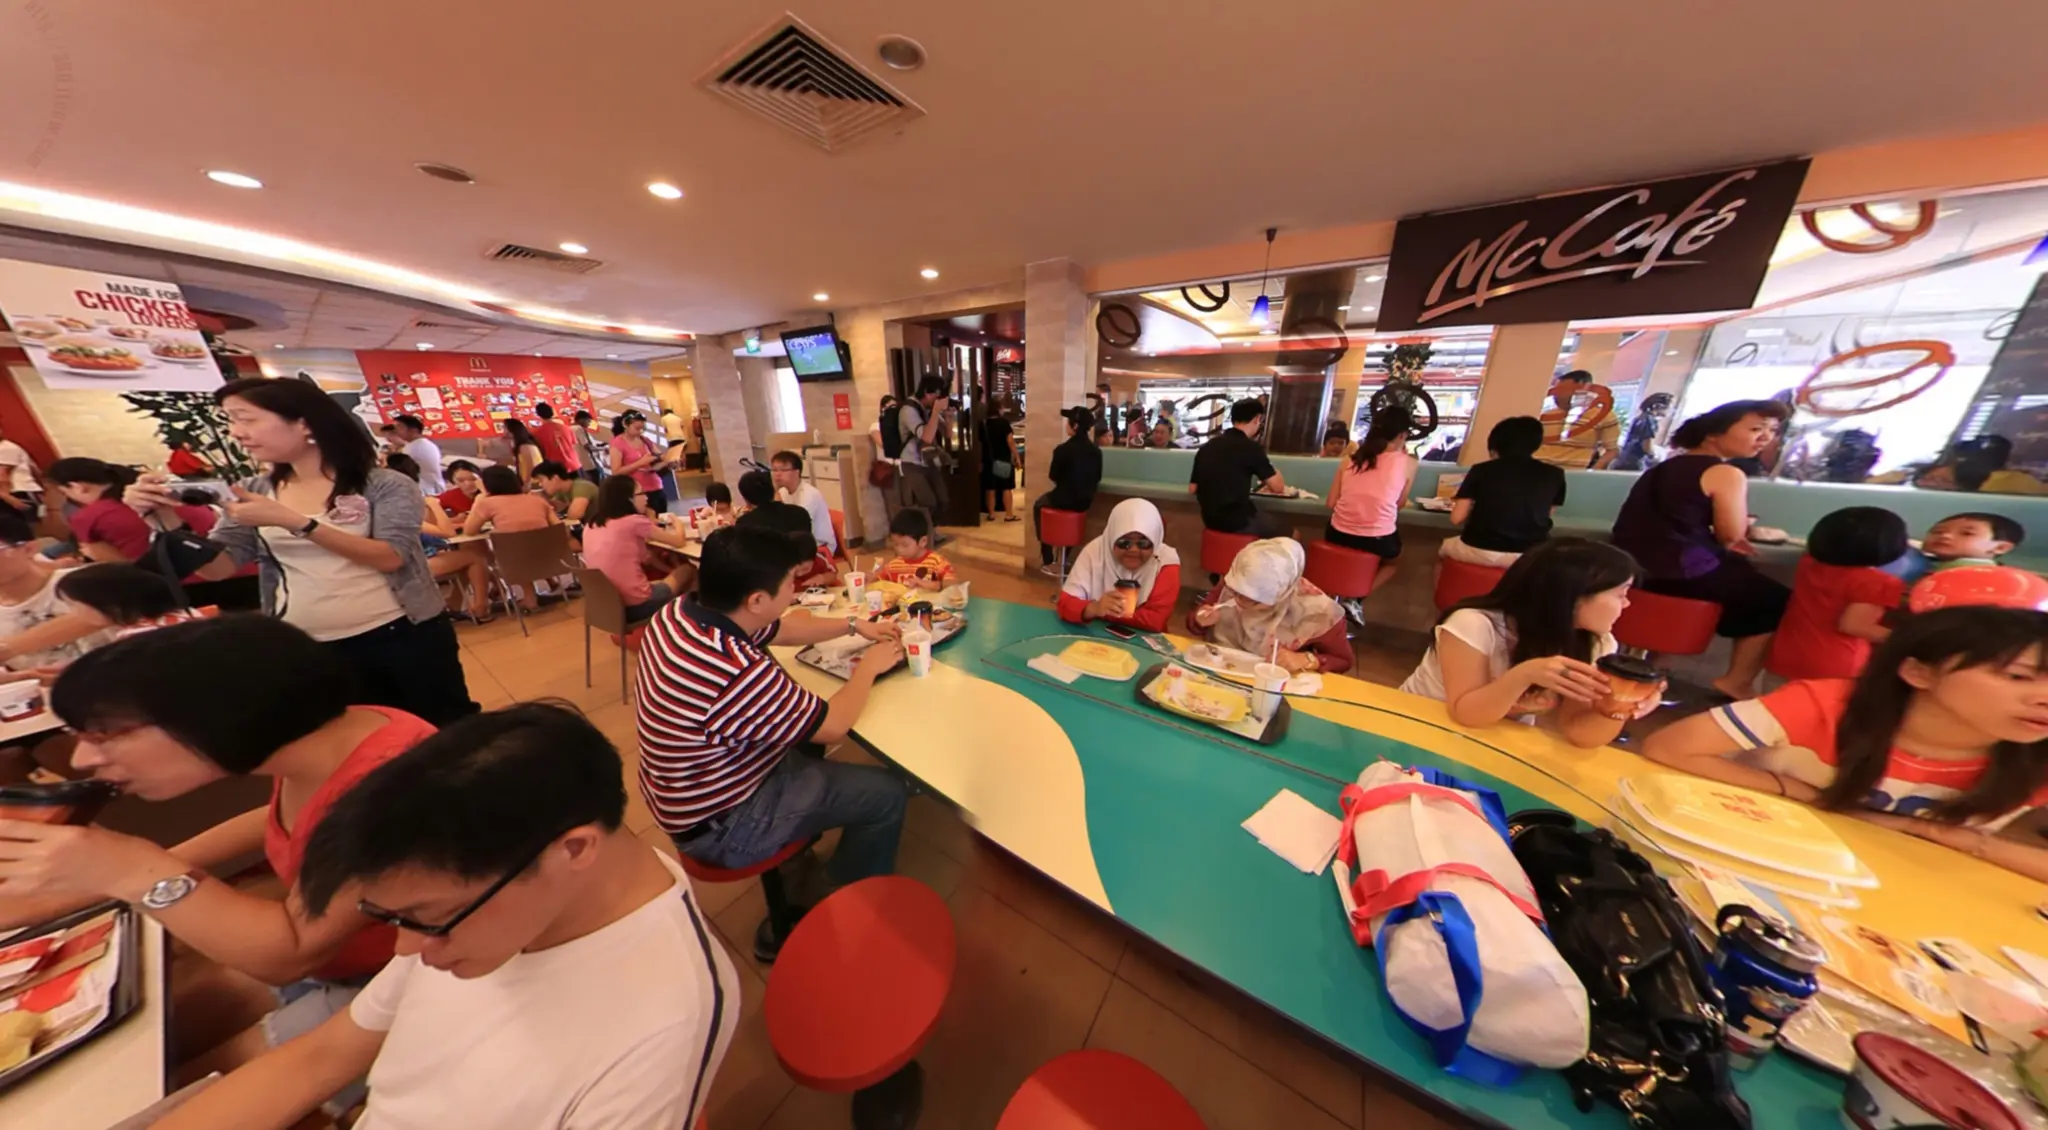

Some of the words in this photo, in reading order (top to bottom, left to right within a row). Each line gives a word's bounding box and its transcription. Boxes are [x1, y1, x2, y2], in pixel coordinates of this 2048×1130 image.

[1423, 169, 1758, 308] McCafé
[105, 282, 152, 298] MADE
[74, 290, 195, 320] CHICKEN
[126, 311, 198, 330] LOVERS
[453, 376, 491, 386] THANK
[493, 377, 515, 386] YOU
